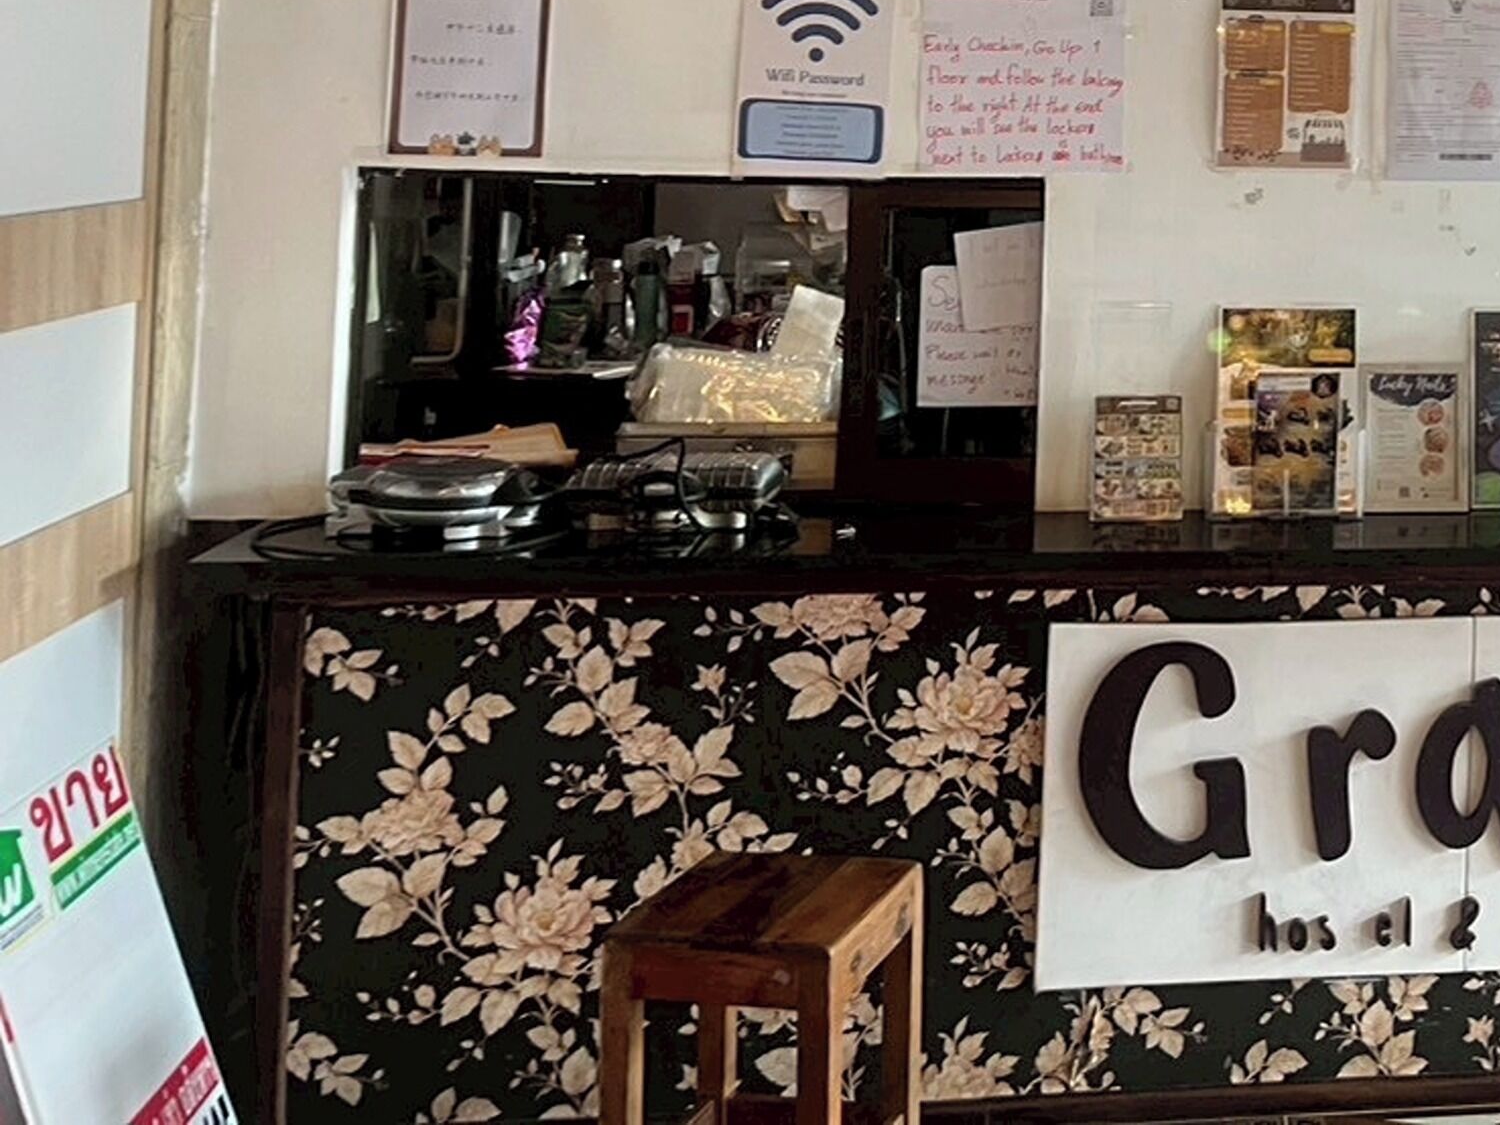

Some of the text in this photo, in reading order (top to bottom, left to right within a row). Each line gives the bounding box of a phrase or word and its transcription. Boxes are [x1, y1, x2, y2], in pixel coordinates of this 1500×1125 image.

[799, 70, 866, 87] Password
[927, 94, 944, 114] to
[949, 92, 975, 114] the
[1045, 93, 1069, 115] the
[925, 125, 955, 154] you
[971, 144, 987, 163] to
[29, 745, 130, 864] ขาย
